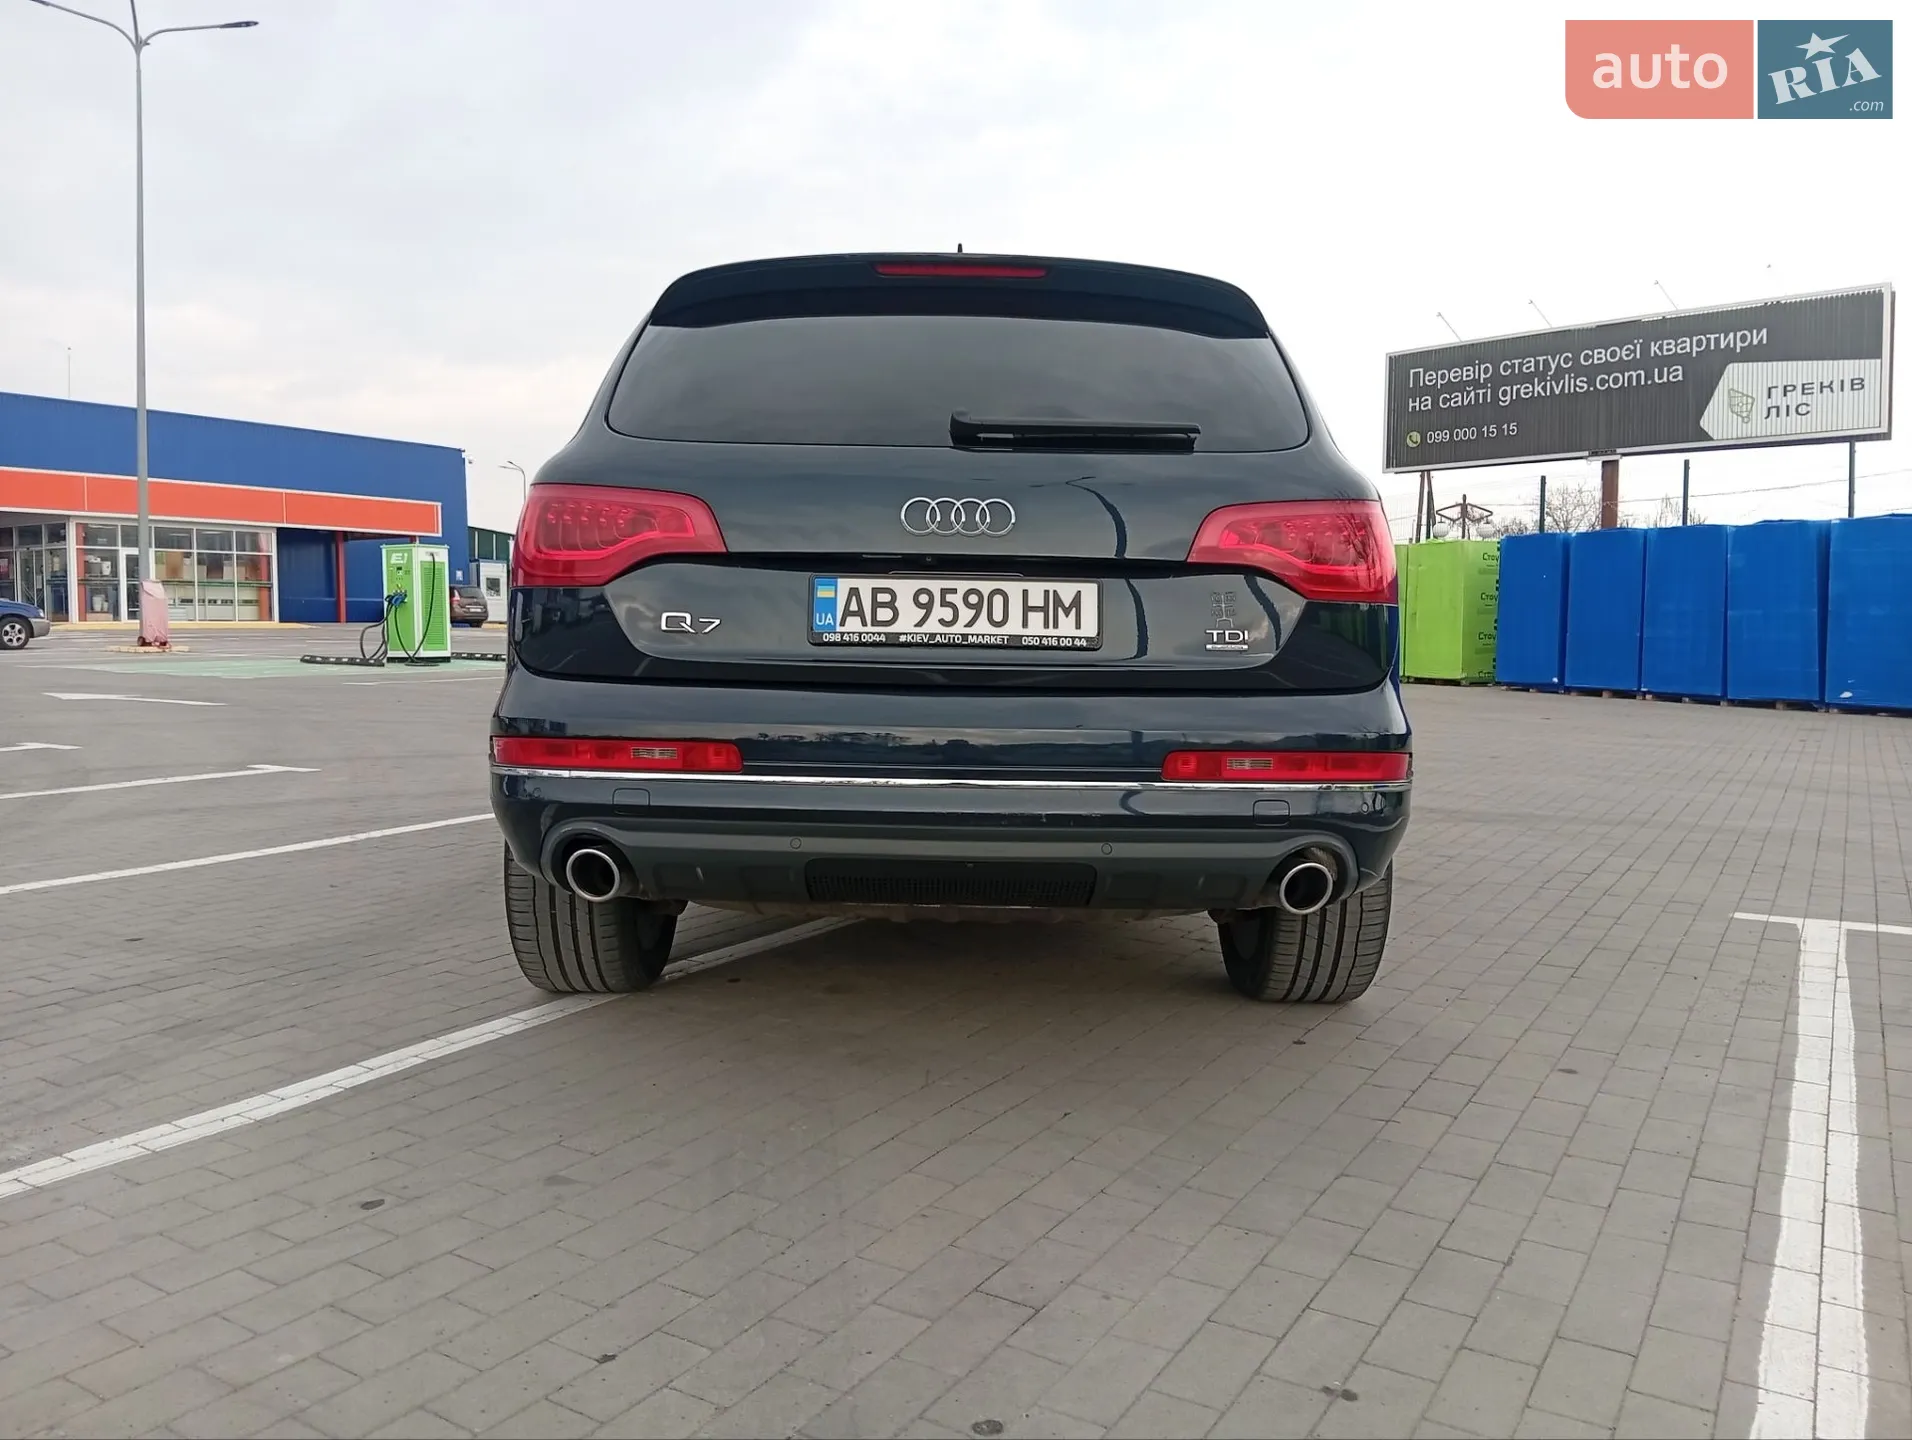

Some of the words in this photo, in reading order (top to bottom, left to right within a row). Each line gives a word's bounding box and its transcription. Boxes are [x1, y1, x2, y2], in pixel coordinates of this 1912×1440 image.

[1409, 360, 1493, 389] Перевір
[1499, 351, 1573, 376] статус
[1580, 338, 1644, 366] своєї
[1650, 327, 1768, 357] квартири
[1408, 395, 1432, 412] на
[1439, 383, 1492, 409] сайті
[1498, 364, 1684, 406] grekivlis.com.ua
[1767, 377, 1866, 399] ГРЕКІВ
[1764, 402, 1811, 420] ЛІС
[1426, 430, 1450, 444] 099
[1453, 427, 1477, 441] 000
[1481, 424, 1498, 438] 15
[1502, 422, 1518, 436] 15
[838, 586, 900, 628] AB
[912, 587, 1010, 629] 9590
[1021, 588, 1082, 631] HM
[816, 612, 834, 626] UA
[822, 632, 841, 642] 098
[842, 632, 860, 642] 416
[861, 633, 886, 643] 0044
[899, 633, 1009, 645] #KIEV_AUTO_MARKET
[1021, 636, 1040, 646] 050
[1041, 637, 1058, 646] 416
[1059, 637, 1073, 647] 00
[1073, 638, 1087, 647] 44
[1205, 629, 1249, 643] TDI
